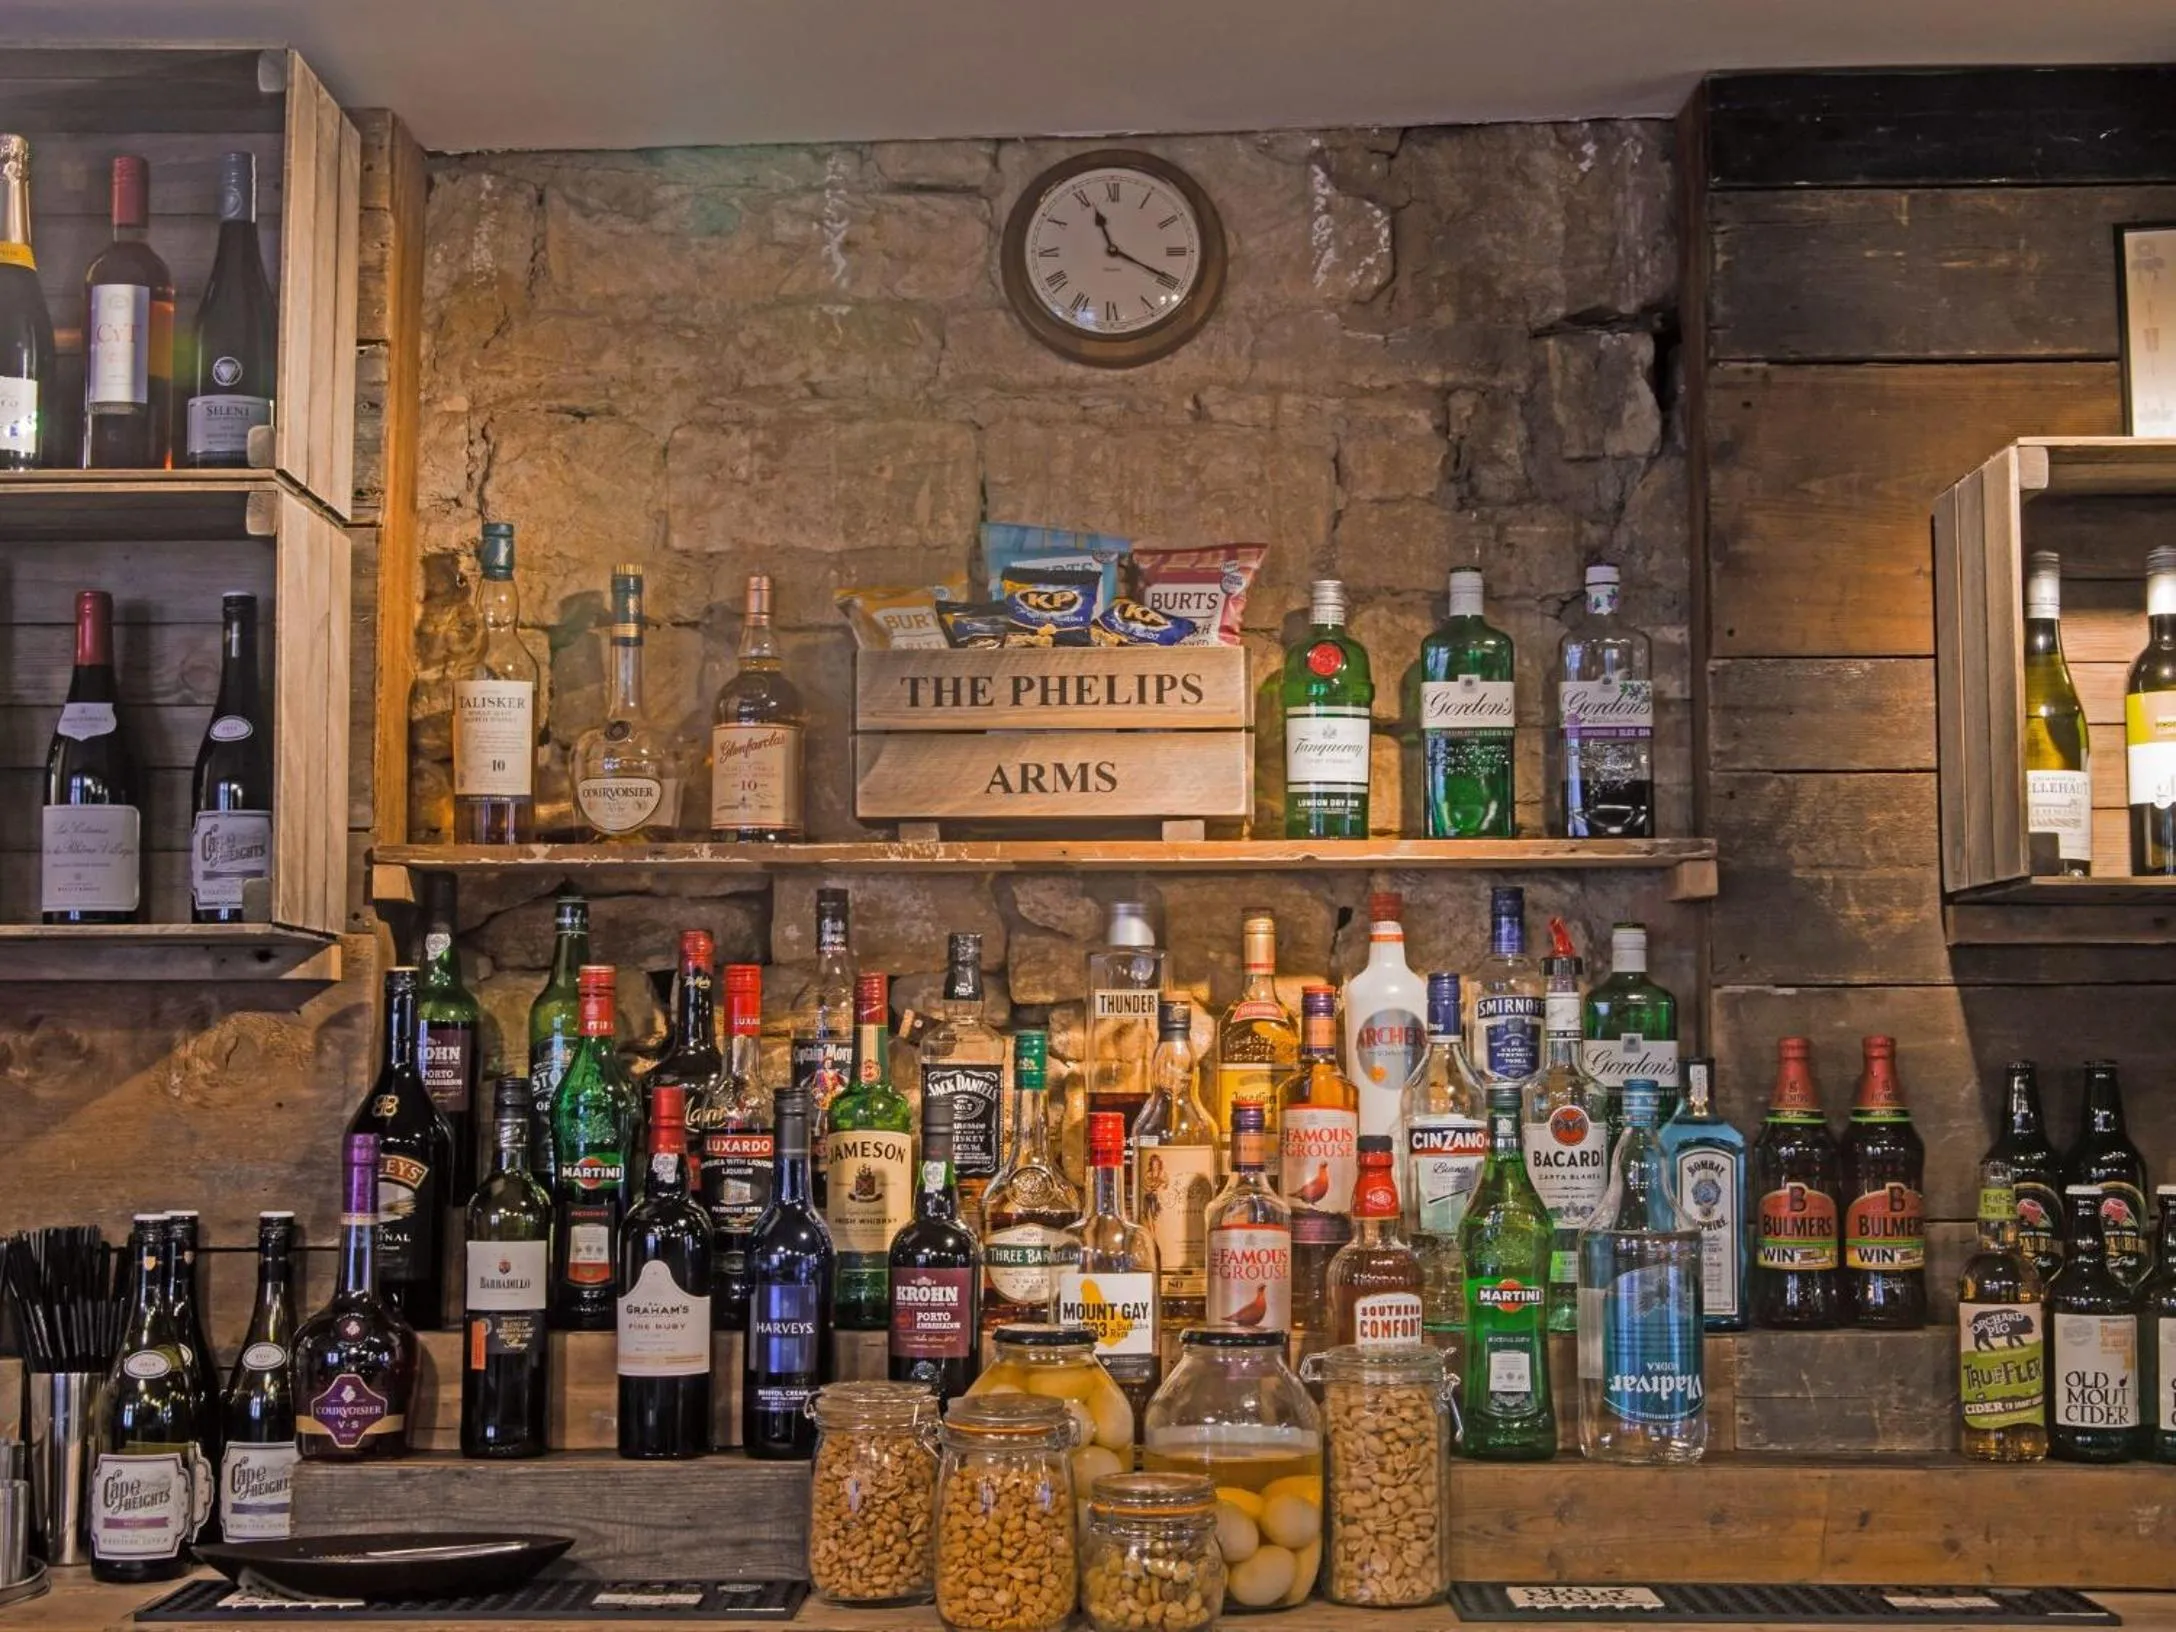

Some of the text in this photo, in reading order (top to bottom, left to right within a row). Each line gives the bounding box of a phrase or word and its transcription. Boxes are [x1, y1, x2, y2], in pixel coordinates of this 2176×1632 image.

[1027, 590, 1077, 609] KP
[1151, 592, 1219, 610] BURTS
[883, 613, 939, 630] BURT
[901, 673, 1204, 707] THE PHELIPS
[459, 695, 526, 710] TALISKER
[1424, 690, 1513, 719] Gordon's
[1562, 690, 1651, 721] Gordon's
[719, 730, 786, 764] Glenfarclas
[1294, 737, 1364, 758] Tanqueray
[491, 759, 506, 773] 10
[984, 760, 1119, 794] ARMS
[582, 785, 654, 800] COURVOISIER
[1100, 994, 1156, 1013] THUNDER
[1478, 997, 1547, 1017] SMIRNOFF
[1359, 1026, 1427, 1048] ARCHER
[824, 1043, 853, 1064] Morg
[1587, 1050, 1678, 1077] Gordon's
[928, 1077, 956, 1097] JACK
[1285, 1127, 1354, 1143] FAMOUS
[1411, 1130, 1486, 1151] CINZANO
[706, 1139, 772, 1153] LUXARDO
[828, 1140, 906, 1165] JAMESON
[1283, 1143, 1354, 1158] GROUSE
[379, 1159, 422, 1180] EYS
[562, 1166, 622, 1179] MARTINI
[1687, 1159, 1727, 1179] BOMBAY
[1789, 1185, 1807, 1212] B
[1888, 1184, 1906, 1212] B
[1696, 1215, 1729, 1232] PHIRE
[1763, 1215, 1833, 1237] BULMERS
[380, 1233, 412, 1242] INAL
[990, 1248, 1024, 1264] THREE
[1220, 1249, 1288, 1265] FAMOUS
[1763, 1248, 1796, 1263] WIN
[1858, 1247, 1896, 1264] WIN
[479, 1276, 532, 1289] BARBADILLO
[1218, 1265, 1288, 1281] GROUSE
[895, 1286, 959, 1302] KROHN
[1479, 1289, 1542, 1302] MARTINI
[626, 1303, 690, 1316] GRAHAM'S
[916, 1311, 952, 1321] PORTO
[1063, 1302, 1150, 1321] MOUNT GAY
[1360, 1303, 1421, 1317] SOUTHERN
[756, 1321, 815, 1335] HARVEYS
[1359, 1316, 1422, 1339] COMFORT
[1971, 1312, 2025, 1334] ORCHARD
[1987, 1322, 2011, 1337] PIG
[1646, 1361, 1680, 1371] VODKA
[1610, 1372, 1704, 1400] Vladivar
[2065, 1371, 2109, 1389] OLD
[2066, 1387, 2131, 1406] MOUT
[315, 1404, 382, 1417] COURVOISIER
[1965, 1401, 2005, 1414] CIDER
[2064, 1404, 2130, 1425] CIDER
[231, 1456, 267, 1500] Cape
[250, 1477, 291, 1498] HEIGHT
[103, 1469, 142, 1515] Cape
[123, 1487, 172, 1512] HEIGHTS
